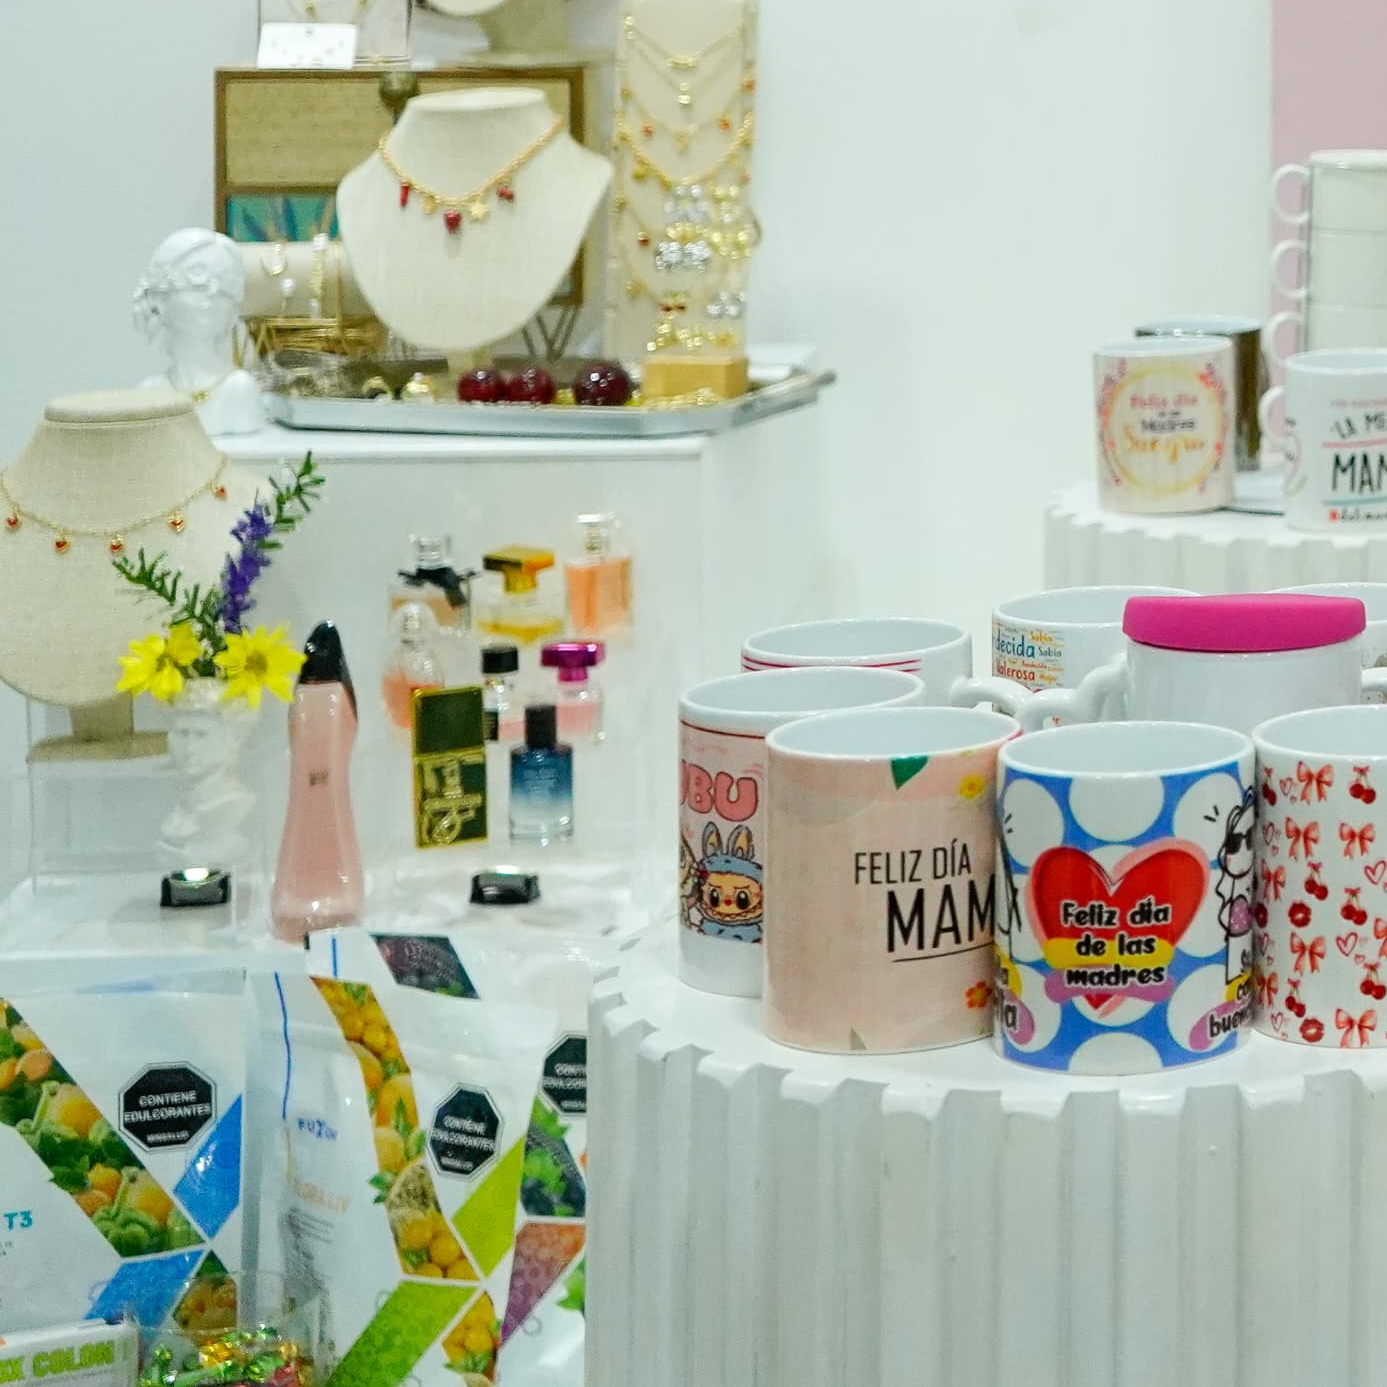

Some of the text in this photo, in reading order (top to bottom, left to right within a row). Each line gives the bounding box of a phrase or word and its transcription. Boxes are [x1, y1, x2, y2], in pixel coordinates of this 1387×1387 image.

[855, 838, 971, 885] FELIZ DÍA
[1062, 896, 1170, 927] Feliz día
[1075, 933, 1156, 957] de las
[1066, 962, 1165, 986] madres
[138, 1089, 198, 1108] CONTIENE
[124, 1102, 212, 1124] EDULCORANTES
